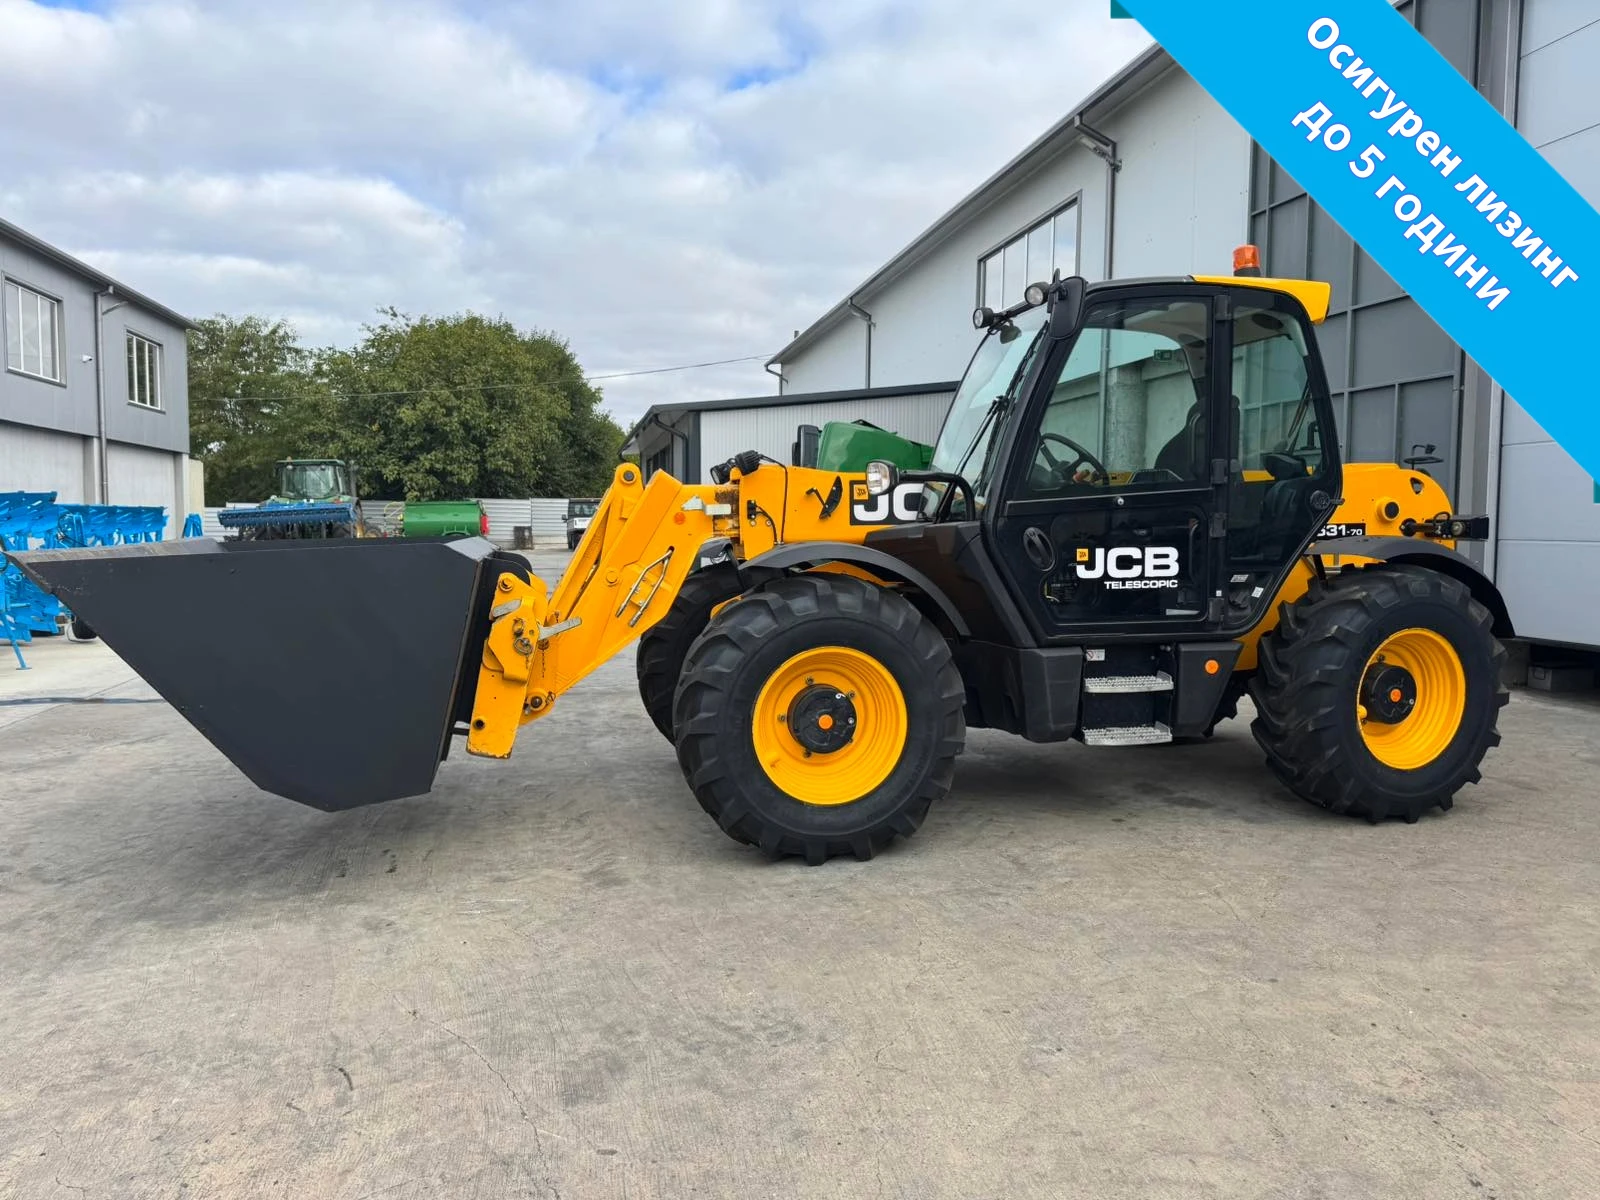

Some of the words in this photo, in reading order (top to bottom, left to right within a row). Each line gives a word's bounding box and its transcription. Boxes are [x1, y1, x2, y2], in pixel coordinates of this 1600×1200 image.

[853, 483, 926, 521] JC
[1076, 547, 1179, 579] JCB
[1104, 580, 1179, 590] TELESCOPIC
